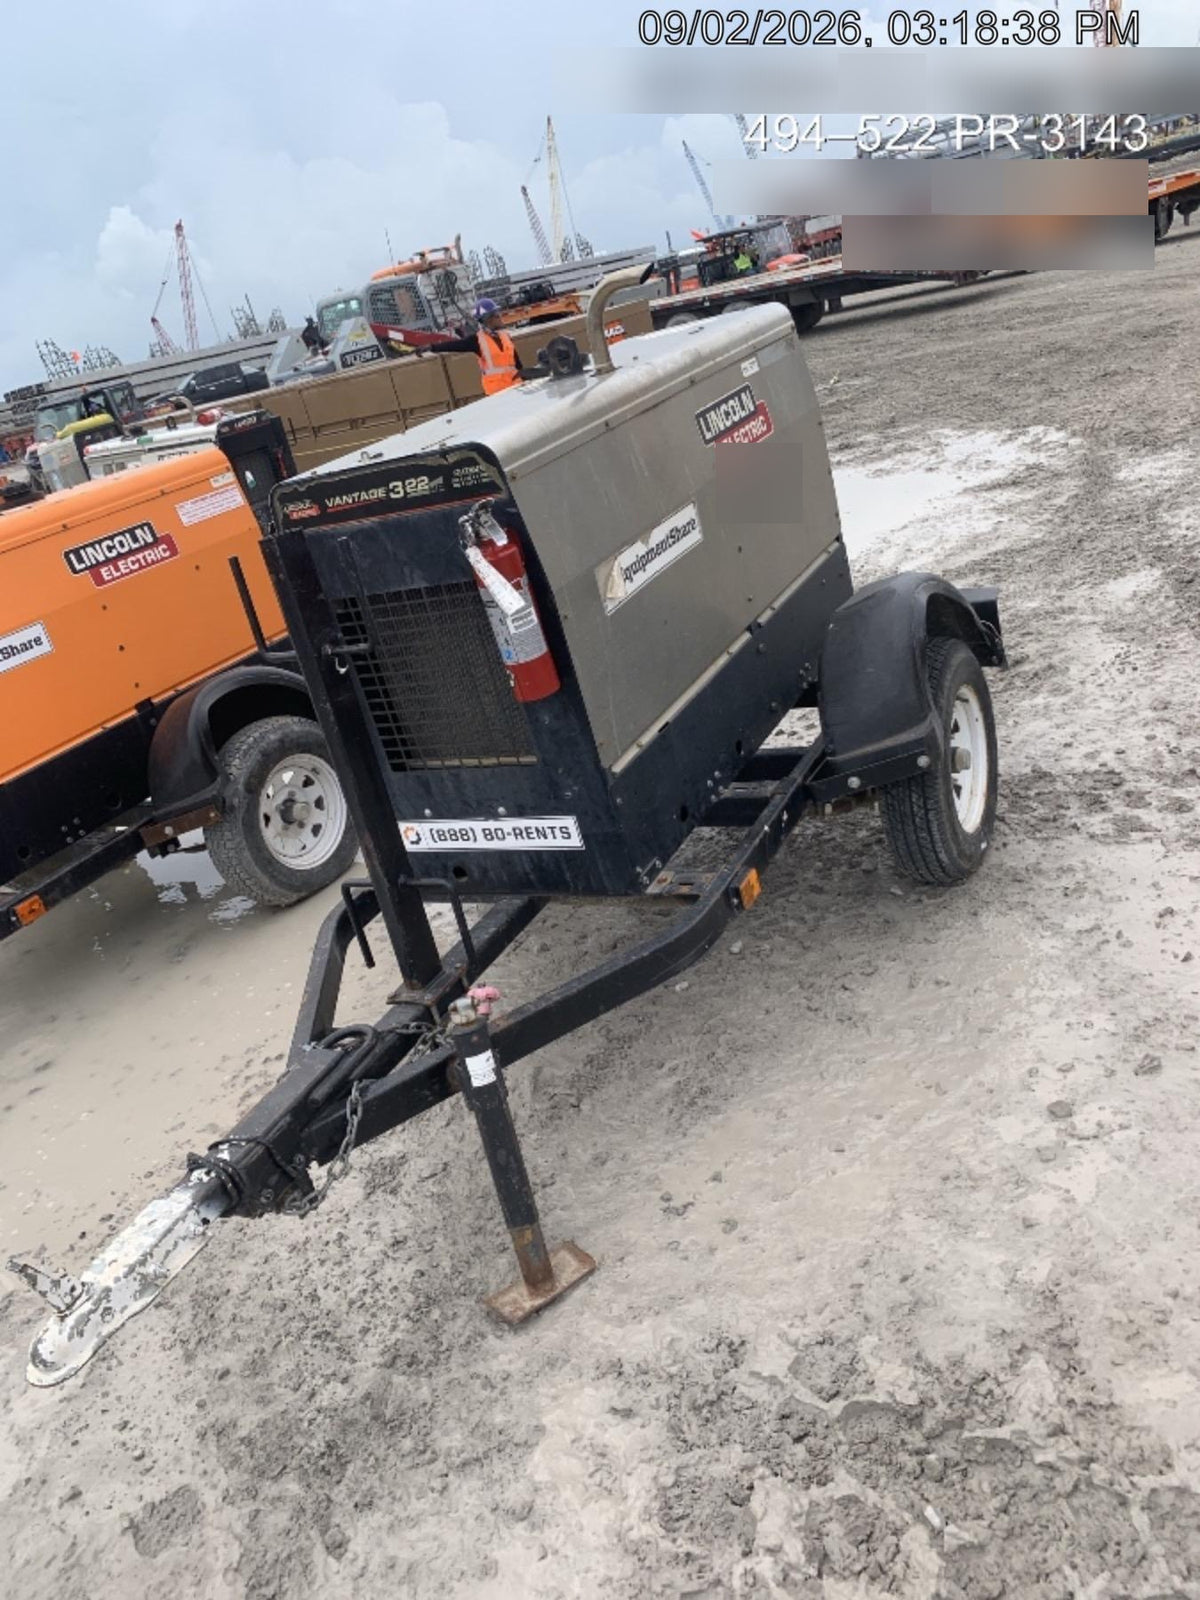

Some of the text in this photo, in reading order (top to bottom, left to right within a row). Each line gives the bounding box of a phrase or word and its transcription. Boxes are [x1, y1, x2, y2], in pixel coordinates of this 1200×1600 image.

[699, 389, 755, 440] LINCOLN
[721, 415, 767, 443] ECTRIC
[324, 487, 387, 508] VANTAGE
[69, 525, 154, 571] LINCOLN
[100, 544, 171, 581] ELECTRIC
[620, 516, 698, 584] quipmentShare
[429, 827, 477, 843] (888)
